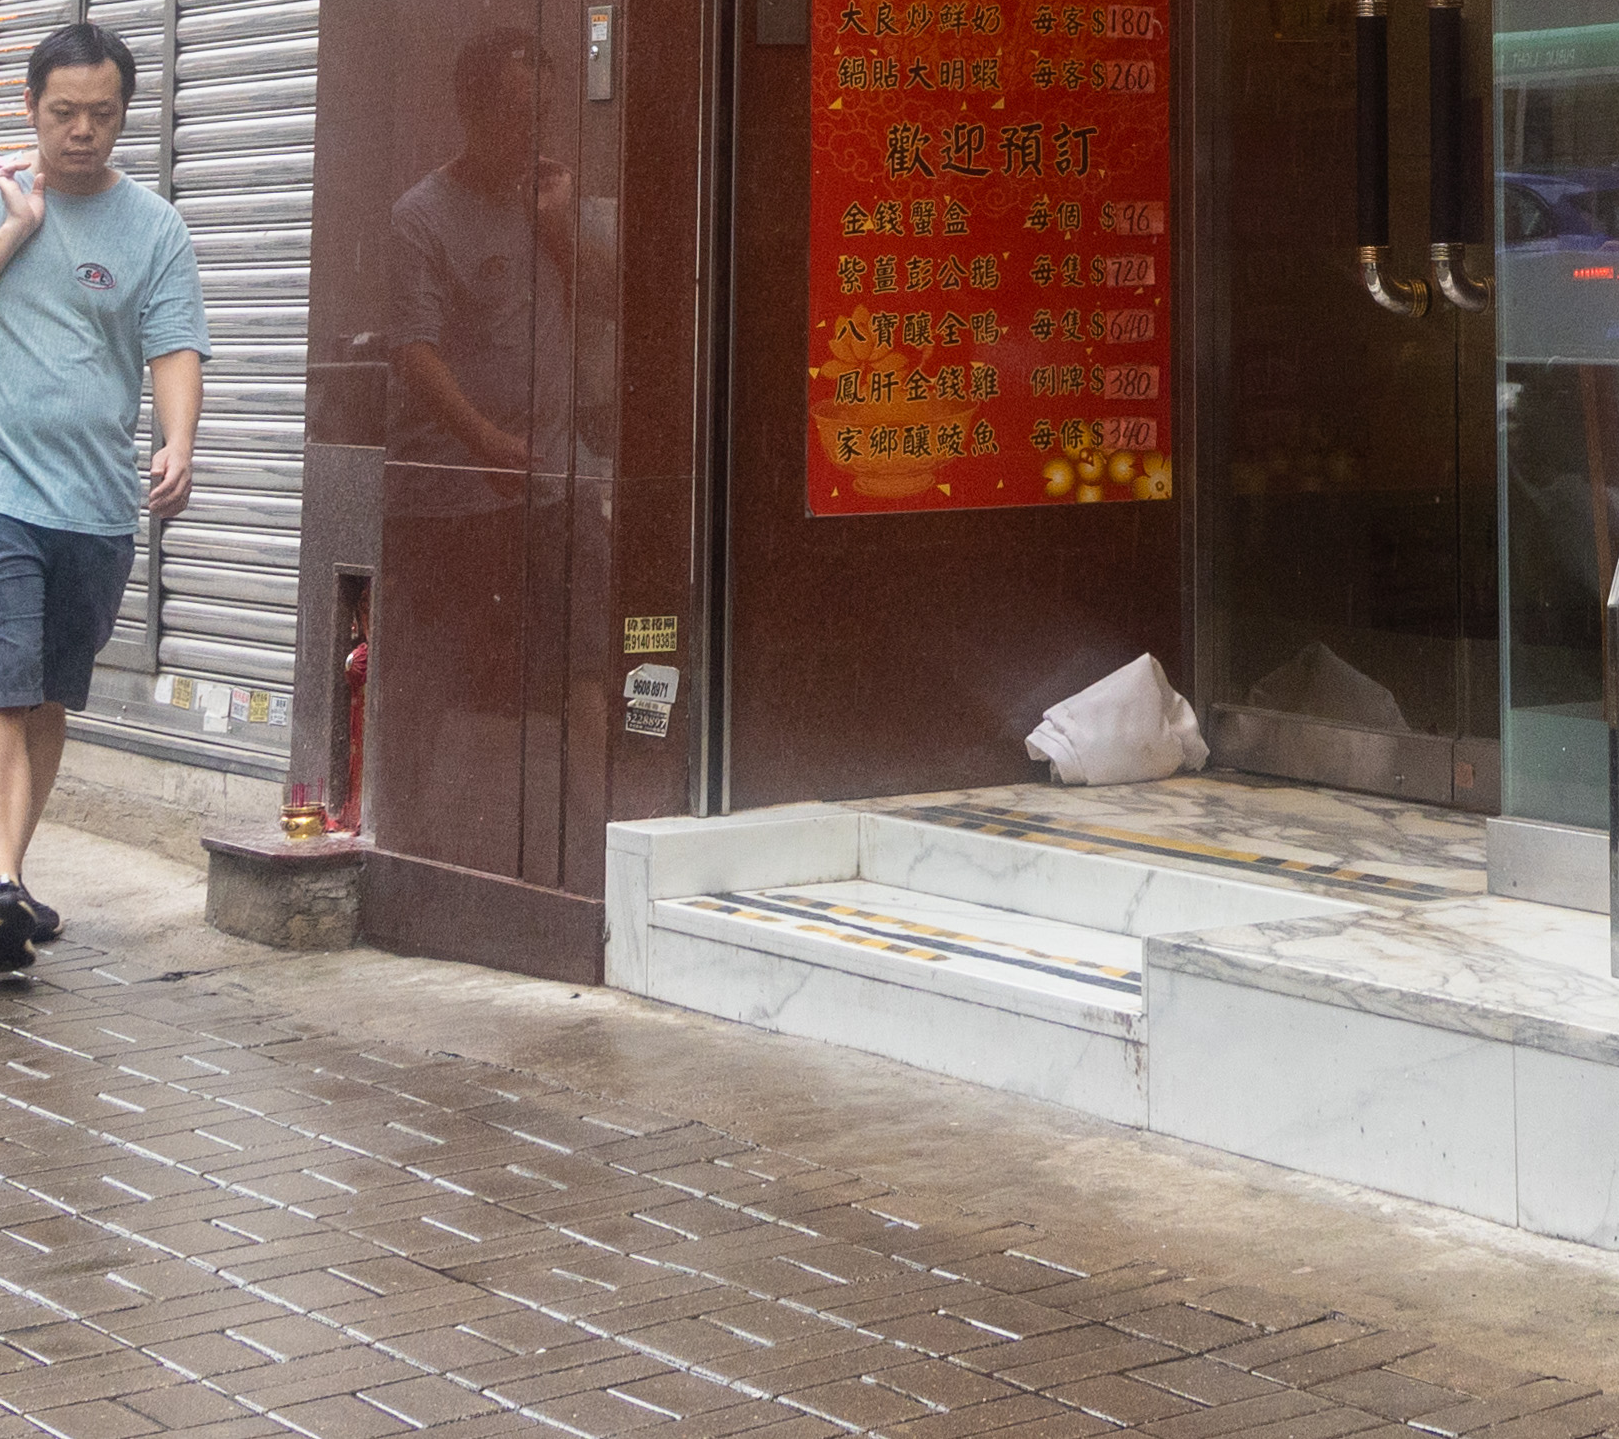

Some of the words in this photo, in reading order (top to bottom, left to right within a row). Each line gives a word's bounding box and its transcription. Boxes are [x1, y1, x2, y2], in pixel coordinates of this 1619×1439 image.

[838, 0, 1002, 37] 大良炒鮮奶
[838, 56, 1002, 91] 鍋貼大明蝦
[885, 122, 1099, 180] 歡迎預訂
[841, 200, 970, 236] 金錢蟹盒
[834, 364, 1000, 405] 鳳肝金錢雞
[836, 420, 1000, 463] 家鄉釀鯪魚
